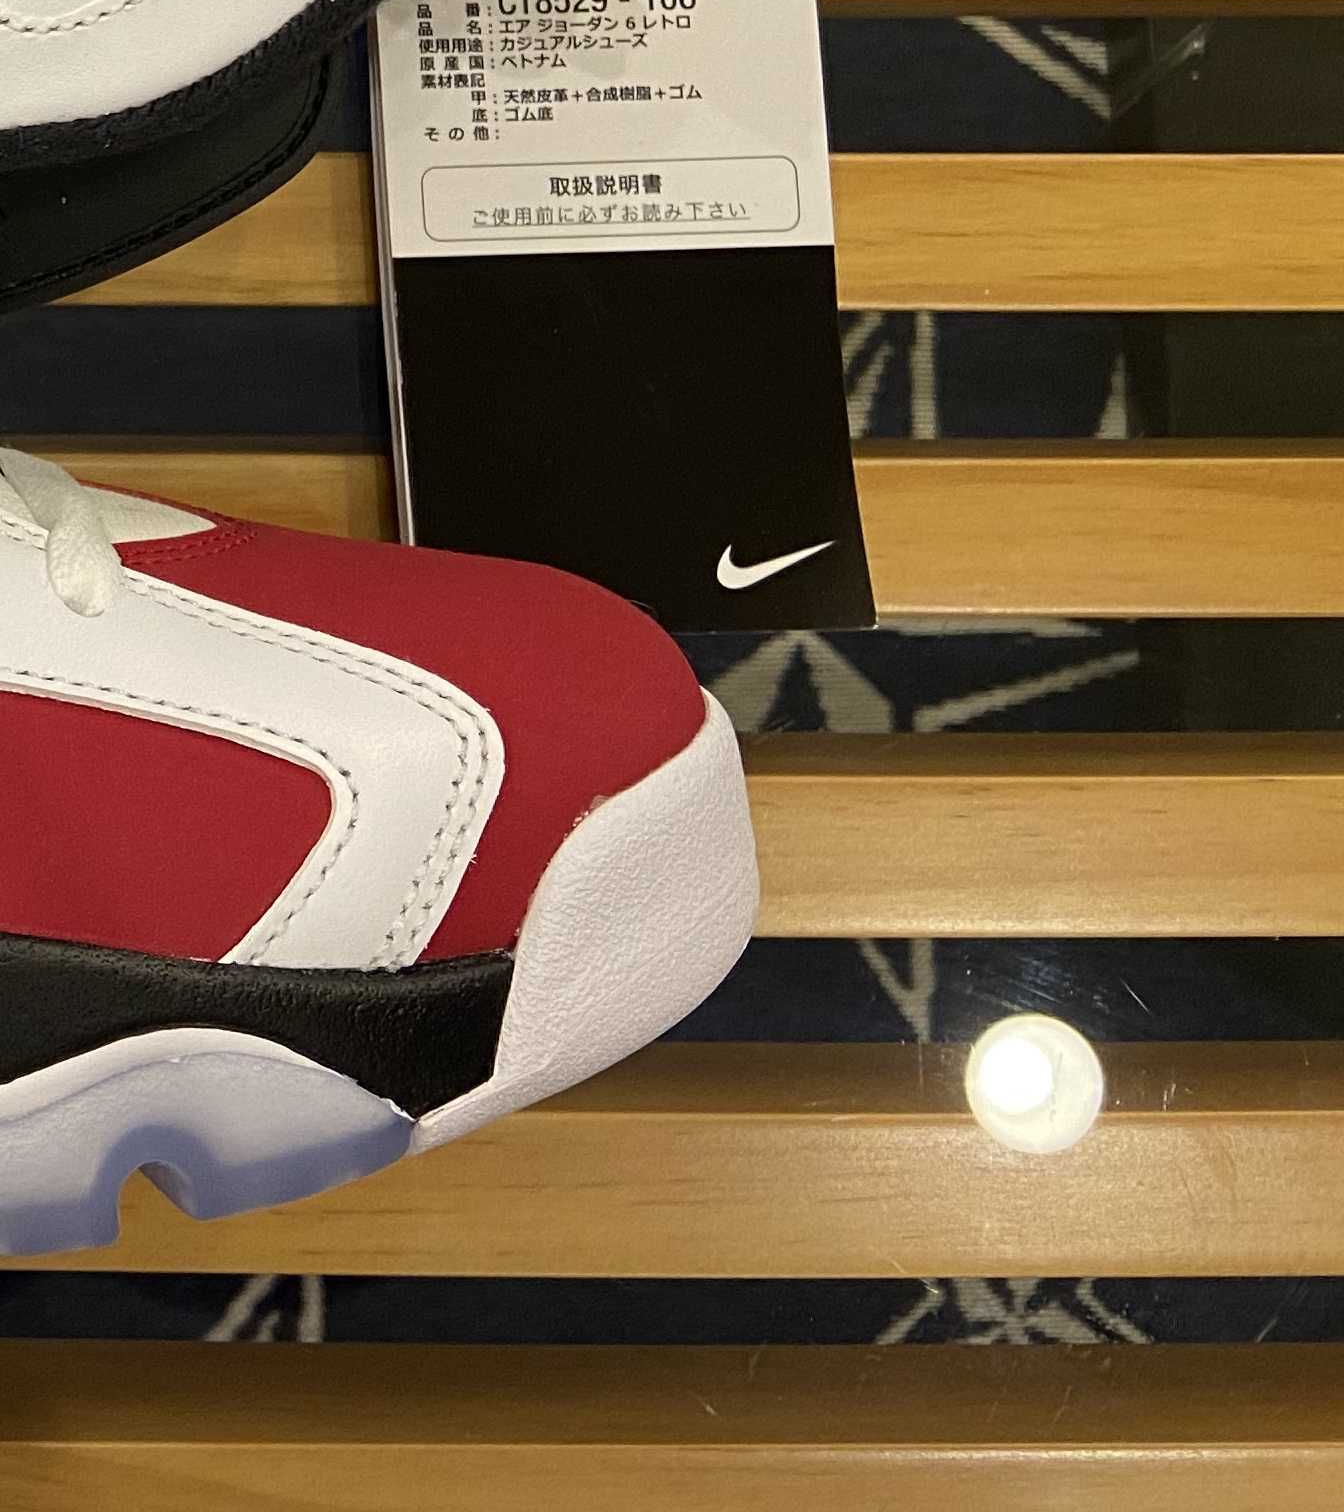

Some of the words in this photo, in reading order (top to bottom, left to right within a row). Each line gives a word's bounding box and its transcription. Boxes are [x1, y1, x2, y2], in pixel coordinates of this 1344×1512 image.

[549, 174, 662, 196] 取扱説明書
